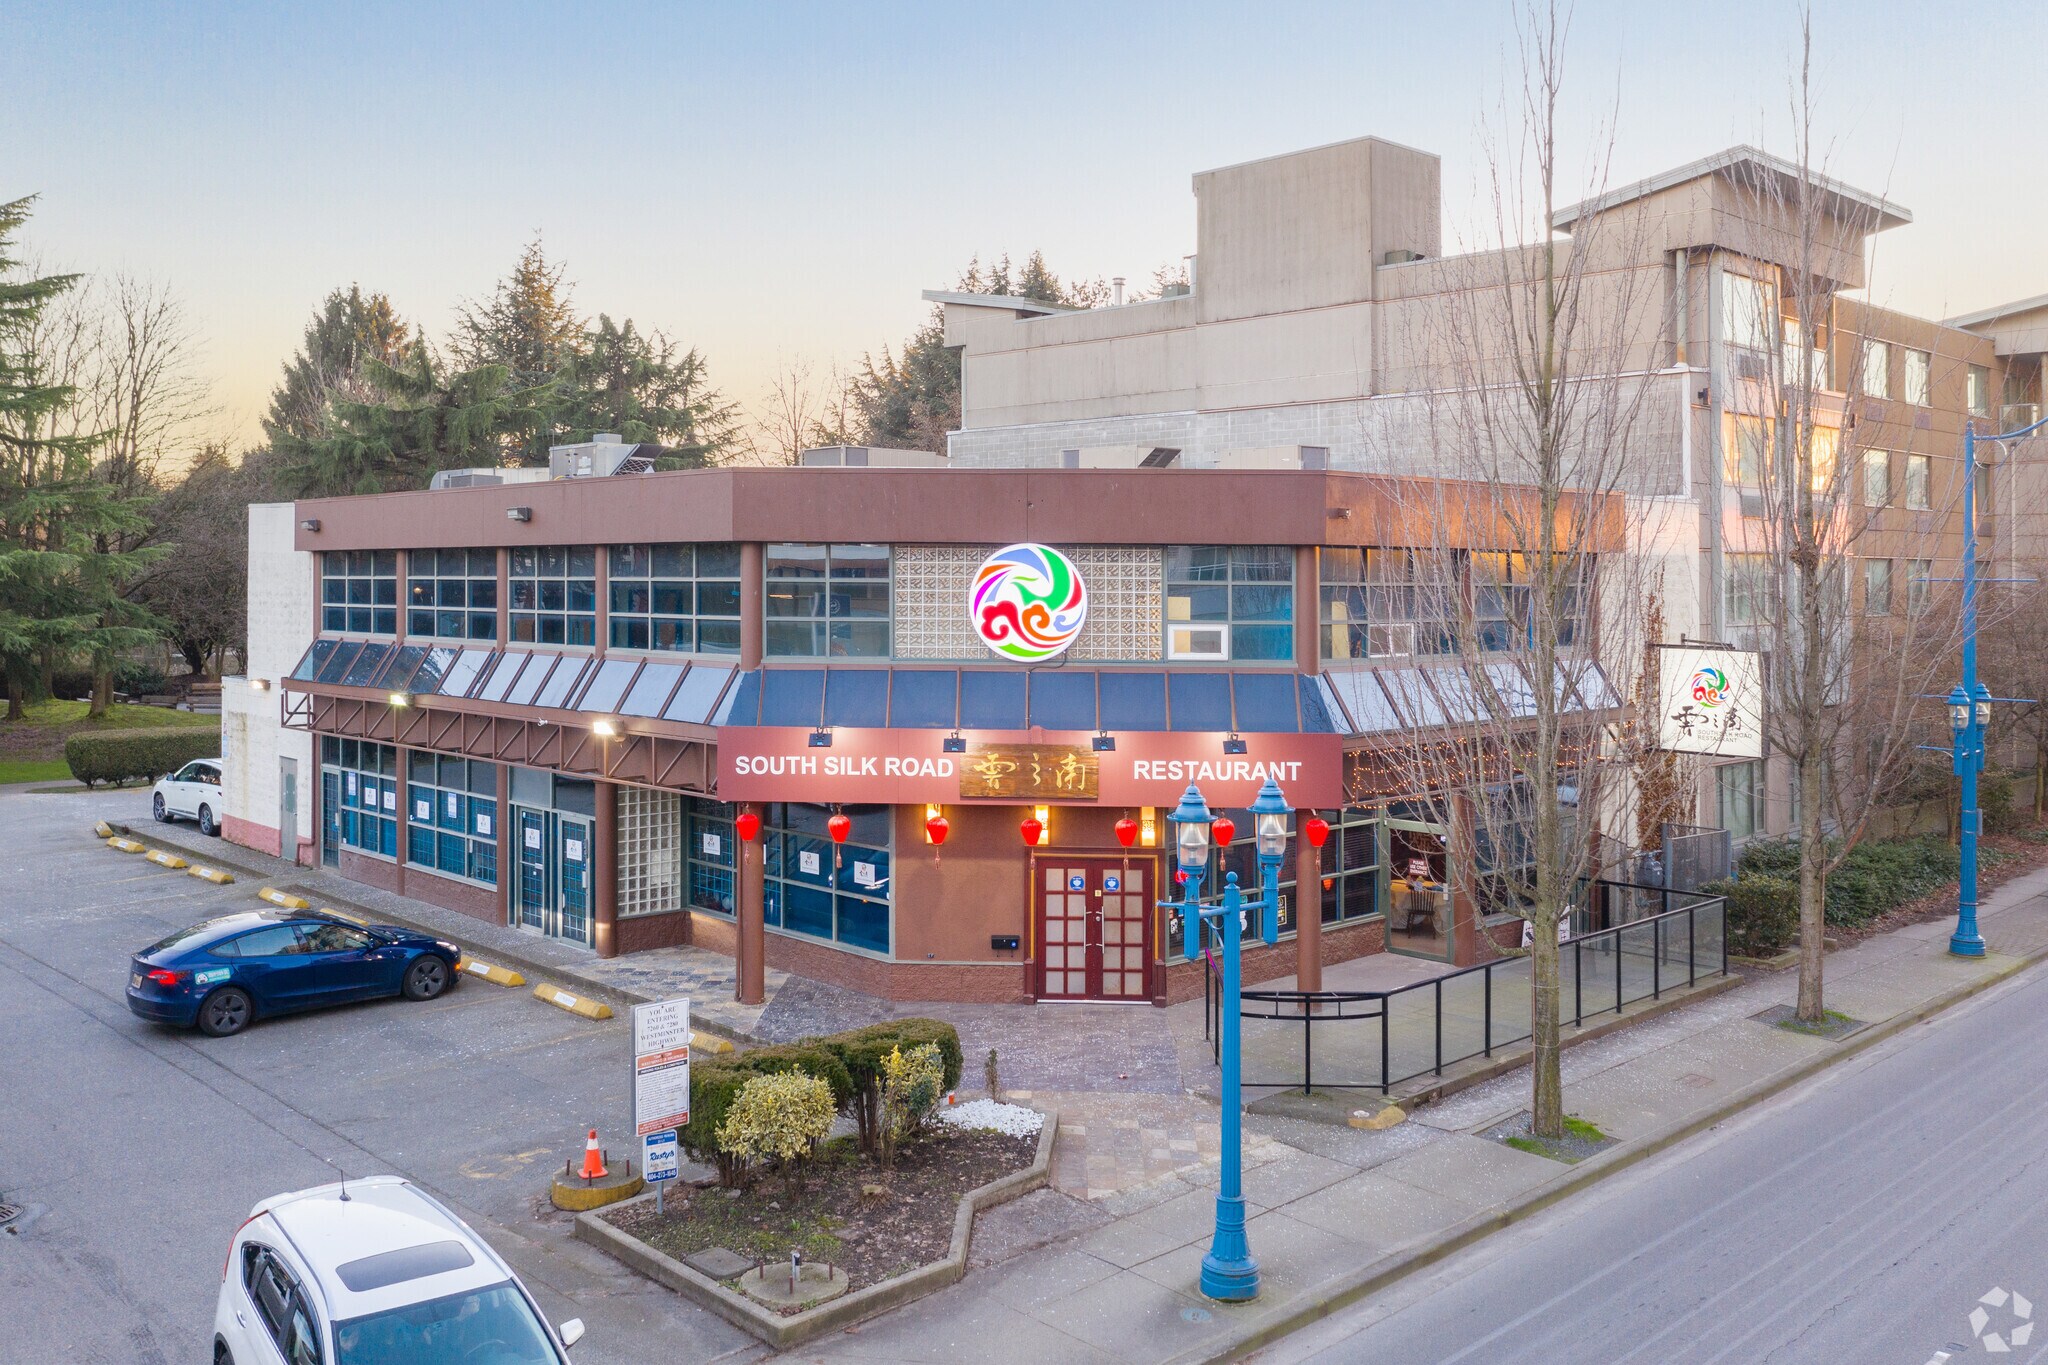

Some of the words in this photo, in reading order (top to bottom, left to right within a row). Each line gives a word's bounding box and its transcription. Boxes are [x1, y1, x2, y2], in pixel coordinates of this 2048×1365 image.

[735, 755, 817, 775] SOUTH
[823, 756, 878, 776] SILK
[884, 757, 954, 777] ROAD
[973, 752, 1086, 791] 雲之南
[1133, 760, 1303, 782] RESTAURANT
[647, 1014, 678, 1024] ENTERING
[640, 1027, 685, 1041] WESTMINSTER
[648, 1036, 678, 1047] HIGHWAY
